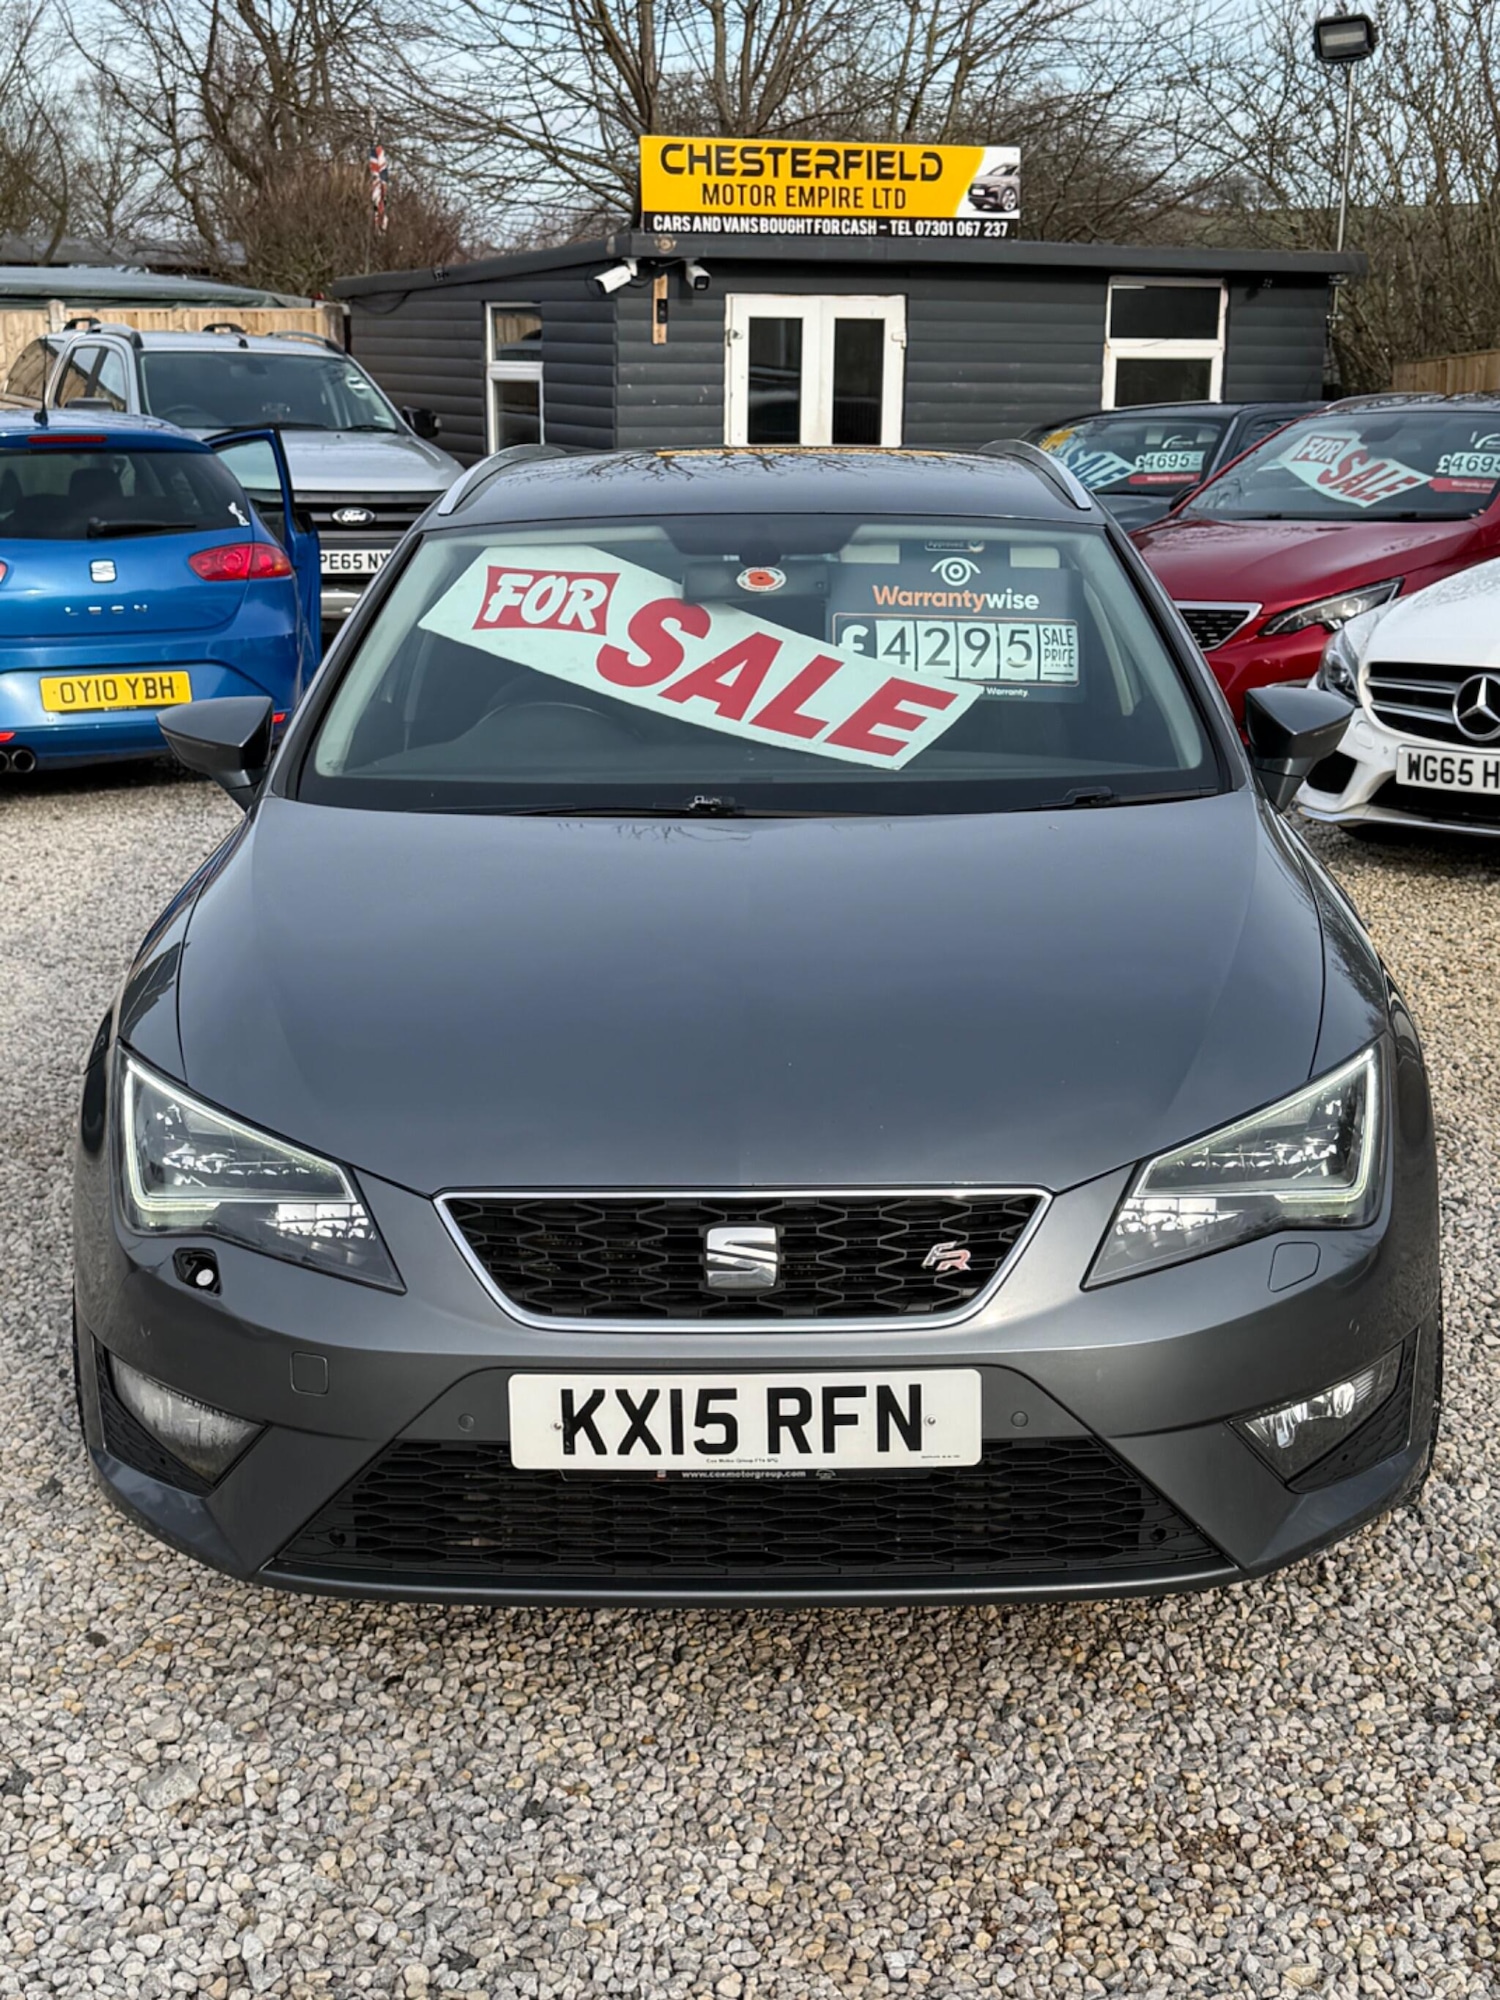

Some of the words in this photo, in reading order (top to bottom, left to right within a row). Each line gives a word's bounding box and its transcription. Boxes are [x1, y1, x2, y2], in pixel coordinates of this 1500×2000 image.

[660, 143, 943, 181] CHESTERFIELD
[702, 183, 776, 207] MOTOR
[786, 186, 864, 208] EMPIRE
[872, 187, 906, 209] LTD
[653, 215, 691, 232] CARS
[692, 216, 721, 233] AND
[722, 216, 758, 233] VANS
[759, 217, 814, 234] BOUGHT
[815, 218, 839, 235] FOR
[841, 218, 876, 235] CASH
[889, 220, 913, 236] TEL
[915, 221, 953, 236] 07301
[956, 221, 981, 236] 067
[984, 222, 1008, 236] 237
[1297, 436, 1345, 463] FOR
[1317, 450, 1419, 501] SALE
[320, 553, 363, 570] PE65
[872, 585, 1040, 613] Warrantywise
[1042, 627, 1075, 647] SALE
[483, 573, 608, 630] FOR
[596, 598, 958, 757] SALE
[60, 679, 118, 703] OY10
[126, 676, 175, 700] YBH
[1407, 753, 1474, 786] WG65
[560, 1388, 739, 1455] KX15
[767, 1384, 923, 1454] RFN
[682, 1469, 806, 1479] www.coxmotorgroup.com
